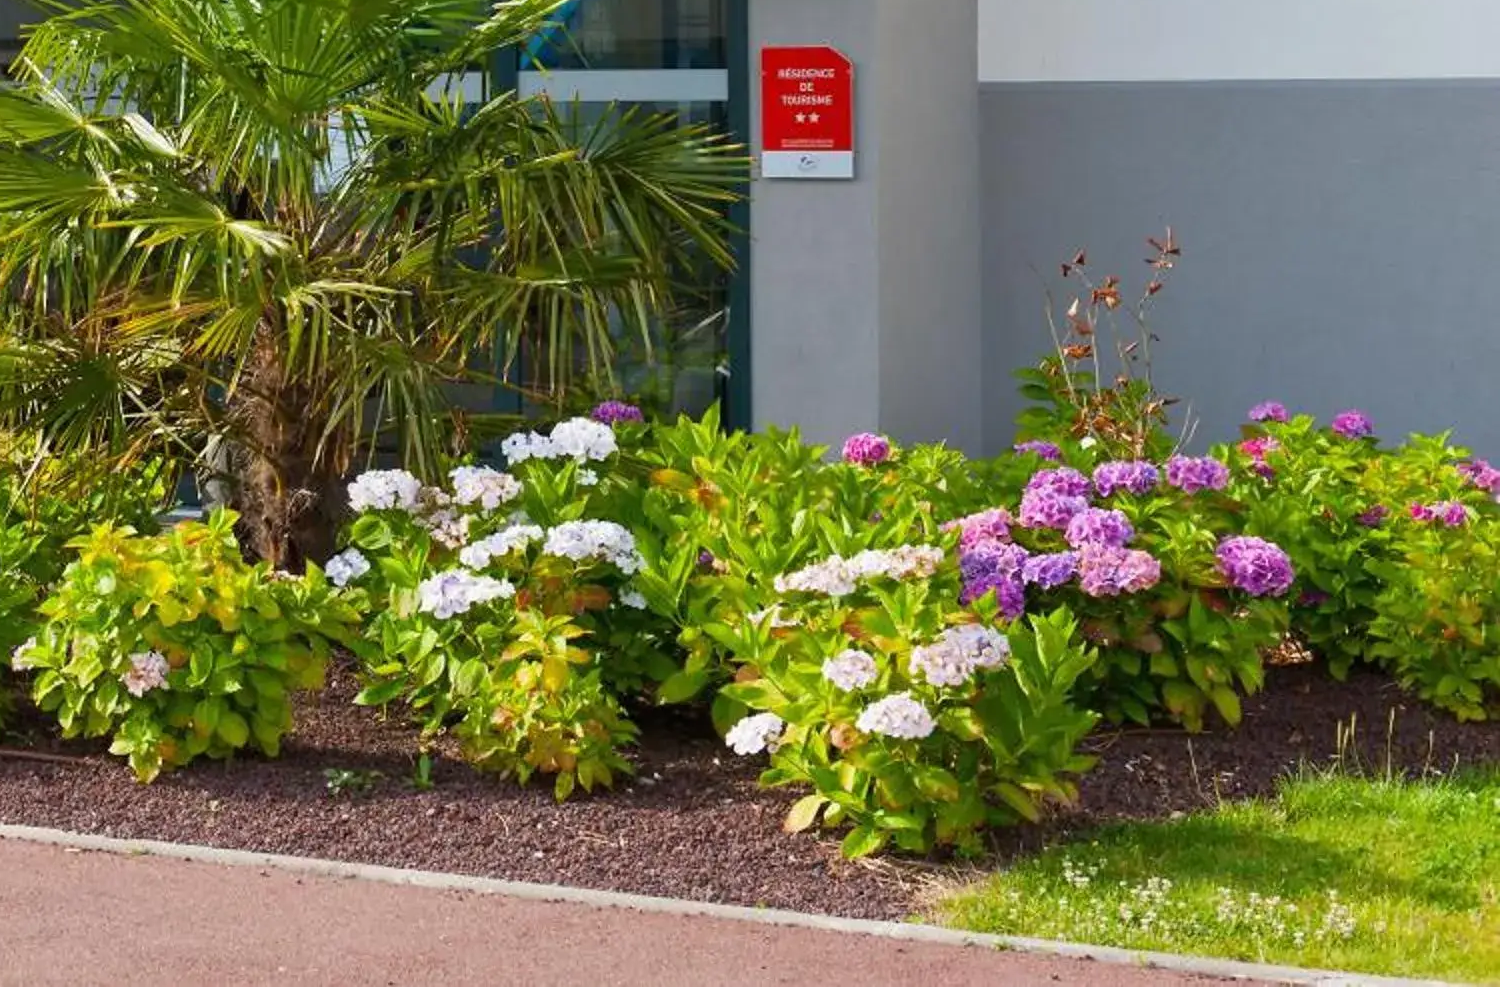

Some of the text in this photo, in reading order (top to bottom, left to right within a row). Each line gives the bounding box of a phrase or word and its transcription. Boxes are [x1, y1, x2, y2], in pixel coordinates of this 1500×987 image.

[778, 68, 835, 78] RÉSIDENCE
[799, 82, 814, 92] DE
[782, 95, 833, 106] TOURISME
